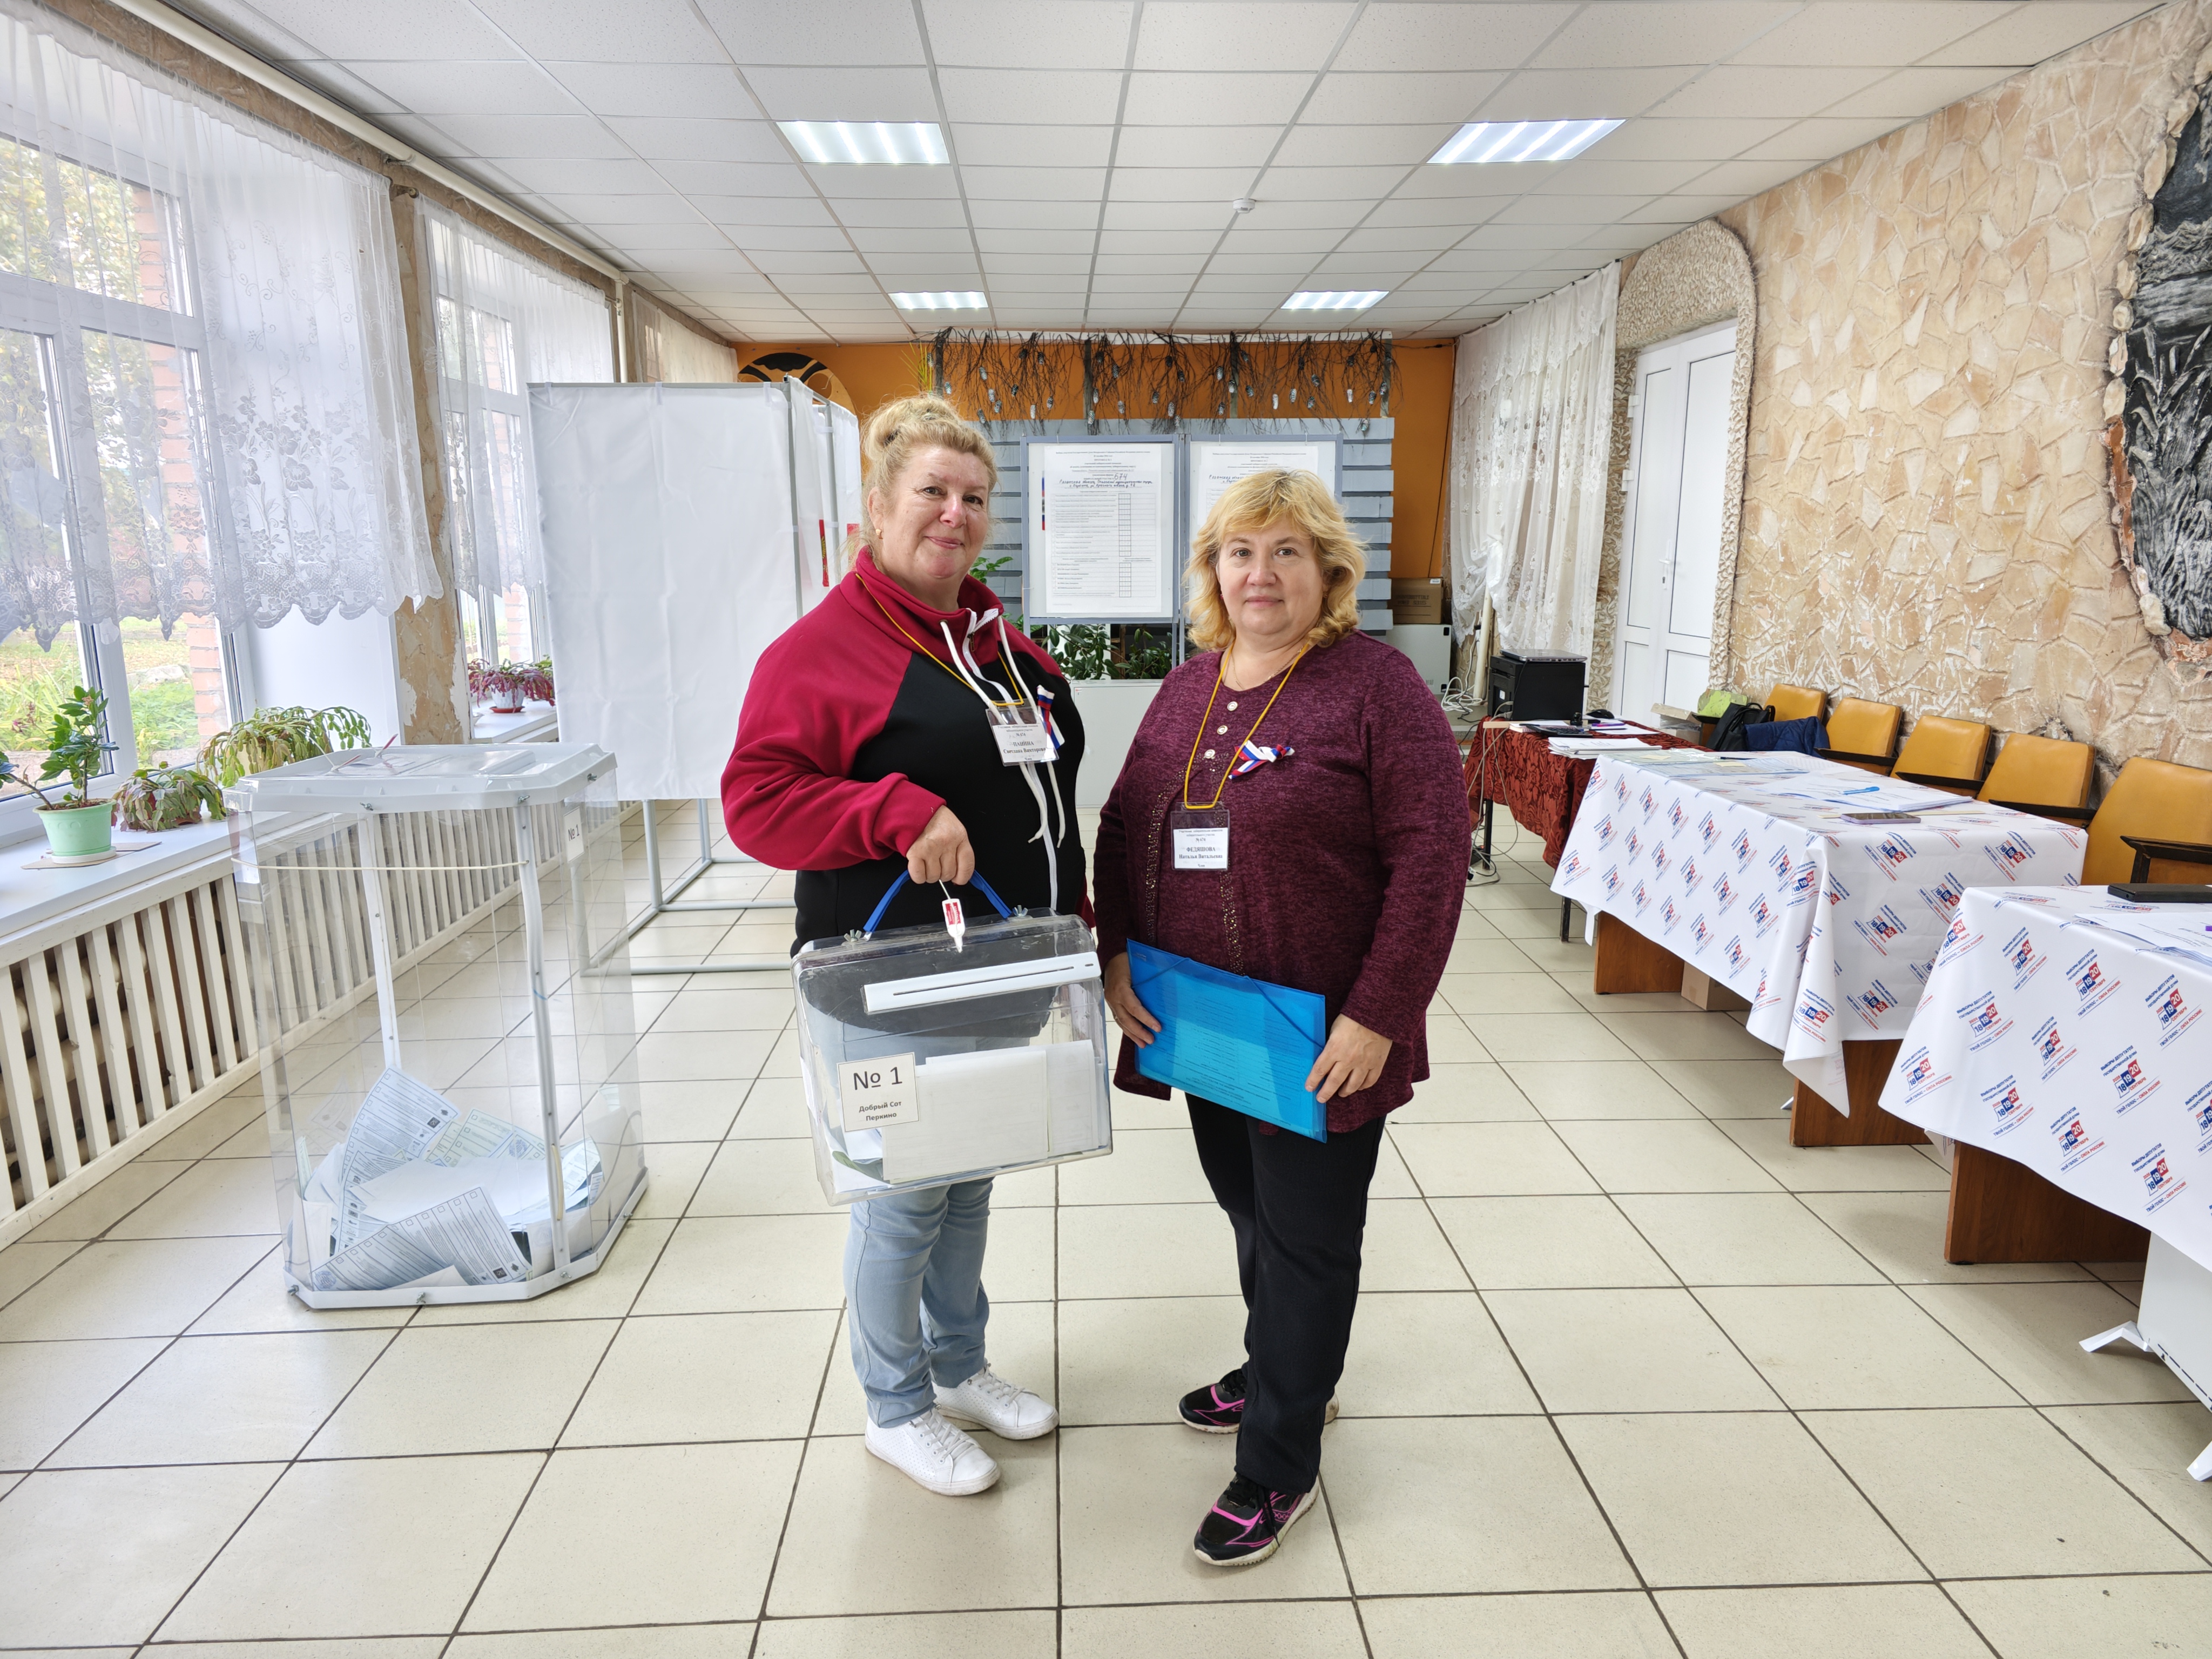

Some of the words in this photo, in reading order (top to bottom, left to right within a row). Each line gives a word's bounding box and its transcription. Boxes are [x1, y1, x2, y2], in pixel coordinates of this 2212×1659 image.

[568, 828, 576, 841] №
[576, 824, 579, 837] 1
[1896, 852, 1904, 861] 20
[2014, 852, 2023, 861] 20
[1831, 895, 1838, 903] 20
[1950, 896, 1958, 904] 20
[1885, 928, 1894, 936] 20
[1948, 932, 1955, 940] 19
[1954, 923, 1963, 933] 20
[2022, 943, 2031, 954] 20
[2019, 953, 2026, 961] 19
[2015, 962, 2022, 970] 18
[2080, 987, 2088, 995] 18
[2085, 976, 2093, 986] 19
[2089, 966, 2100, 977] 20
[2090, 978, 2106, 993] СЕНТЯБРЯ
[2170, 993, 2181, 1005] 20
[1877, 1002, 1885, 1010] 20
[2166, 1004, 2175, 1014] 19
[1816, 1012, 1826, 1021] 20
[1974, 1024, 1984, 1033] 18
[1980, 1015, 1990, 1024] 19
[1986, 1007, 1997, 1016] 20
[2161, 1014, 2170, 1024] 18
[2043, 1051, 2049, 1061] 18
[2047, 1043, 2053, 1052] 19
[2050, 1033, 2059, 1044] 20
[2101, 1058, 2115, 1070] ВЫБОРЫ
[853, 1071, 881, 1090] №
[890, 1067, 902, 1085] 1
[1910, 1078, 1917, 1086] 18
[1915, 1070, 1923, 1078] 19
[1920, 1061, 1930, 1071] 20
[2118, 1083, 2127, 1092] 18
[2123, 1074, 2133, 1083] 19
[2128, 1064, 2140, 1075] 20
[2130, 1077, 2146, 1090] СЕНТЯБРЯ
[859, 1102, 888, 1113] Добрый
[1998, 1108, 2006, 1117] 18
[2003, 1100, 2012, 1109] 19
[2008, 1091, 2018, 1101] 20
[2116, 1105, 2126, 1114] ТВОЙ
[2139, 1090, 2148, 1098] СИЛА
[866, 1112, 897, 1121] Перкино
[2062, 1142, 2070, 1151] 18
[2067, 1134, 2075, 1143] 19
[2072, 1124, 2082, 1135] 20
[2148, 1181, 2156, 1190] 18
[2152, 1171, 2161, 1182] 19
[2157, 1162, 2167, 1173] 20
